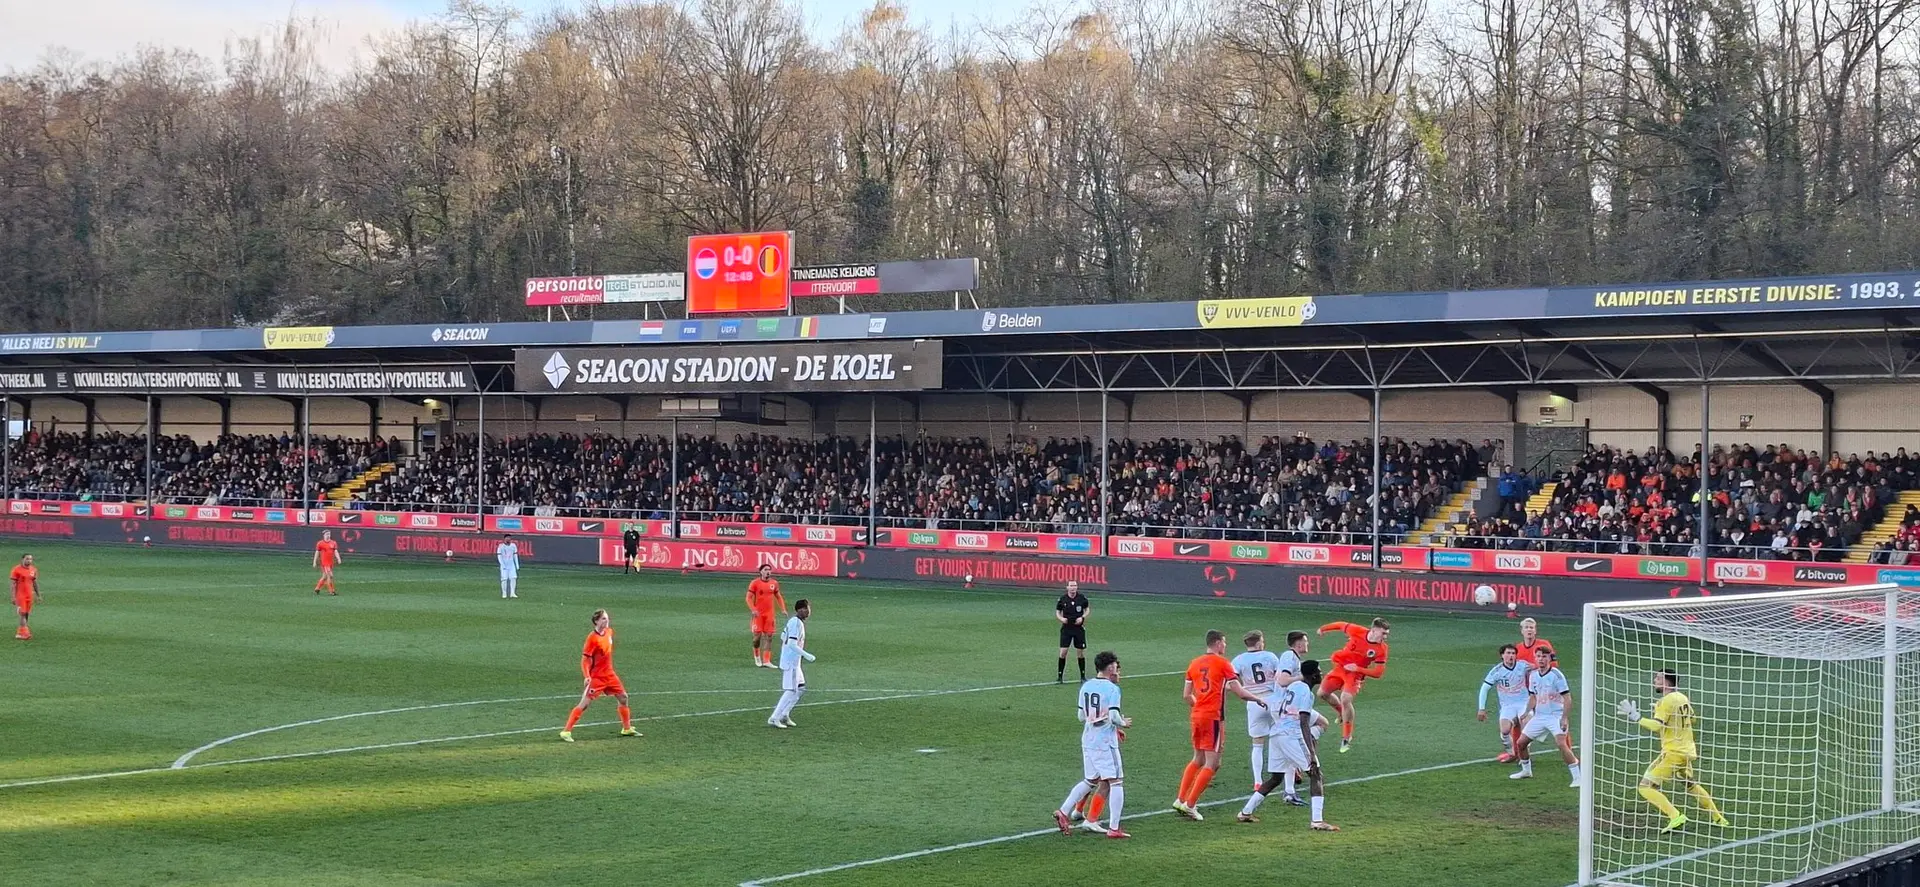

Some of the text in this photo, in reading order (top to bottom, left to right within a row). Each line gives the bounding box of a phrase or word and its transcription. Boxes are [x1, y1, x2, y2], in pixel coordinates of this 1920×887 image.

[724, 246, 753, 266] 0-0
[793, 268, 838, 280] TINNEMANS
[527, 277, 603, 297] personato
[811, 282, 857, 293] ITTERVOORT
[560, 293, 603, 304] recruitment
[1595, 288, 1687, 307] KAMPIOEN
[1692, 286, 1761, 305] EERSTE
[1767, 284, 1842, 302] DIVISIE:
[1849, 281, 1905, 300] 1993,
[1226, 305, 1296, 319] VVV-VENLO
[999, 313, 1042, 328] Belden
[280, 333, 323, 343] VVV-VENLO
[443, 328, 490, 341] SEACON
[55, 337, 66, 349] IS
[575, 358, 668, 384] SEACON
[672, 356, 777, 382] STADION
[794, 355, 827, 381] DE
[830, 353, 895, 380] KOEL
[413, 516, 427, 525] ING
[537, 520, 551, 530] ING
[807, 530, 823, 539] ING
[957, 536, 974, 546] ING
[1014, 538, 1038, 548] bitvavo
[1120, 543, 1139, 552] ING
[1246, 546, 1262, 557] kpn
[684, 548, 718, 566] ING
[756, 551, 793, 570] ING
[1291, 550, 1312, 560] ING
[1498, 557, 1521, 568] ING
[915, 557, 1108, 584] GET YOURS AT NIKE.COM/FOOTBALL
[1659, 563, 1680, 576] kpn
[1717, 565, 1744, 577] ING
[1808, 569, 1846, 581] bitvavo
[1299, 575, 1322, 595] GET
[1327, 577, 1370, 597] YOURS
[1374, 579, 1390, 598] AT
[1251, 662, 1266, 685] 6
[1200, 668, 1210, 693] 3
[1084, 692, 1101, 718] 19
